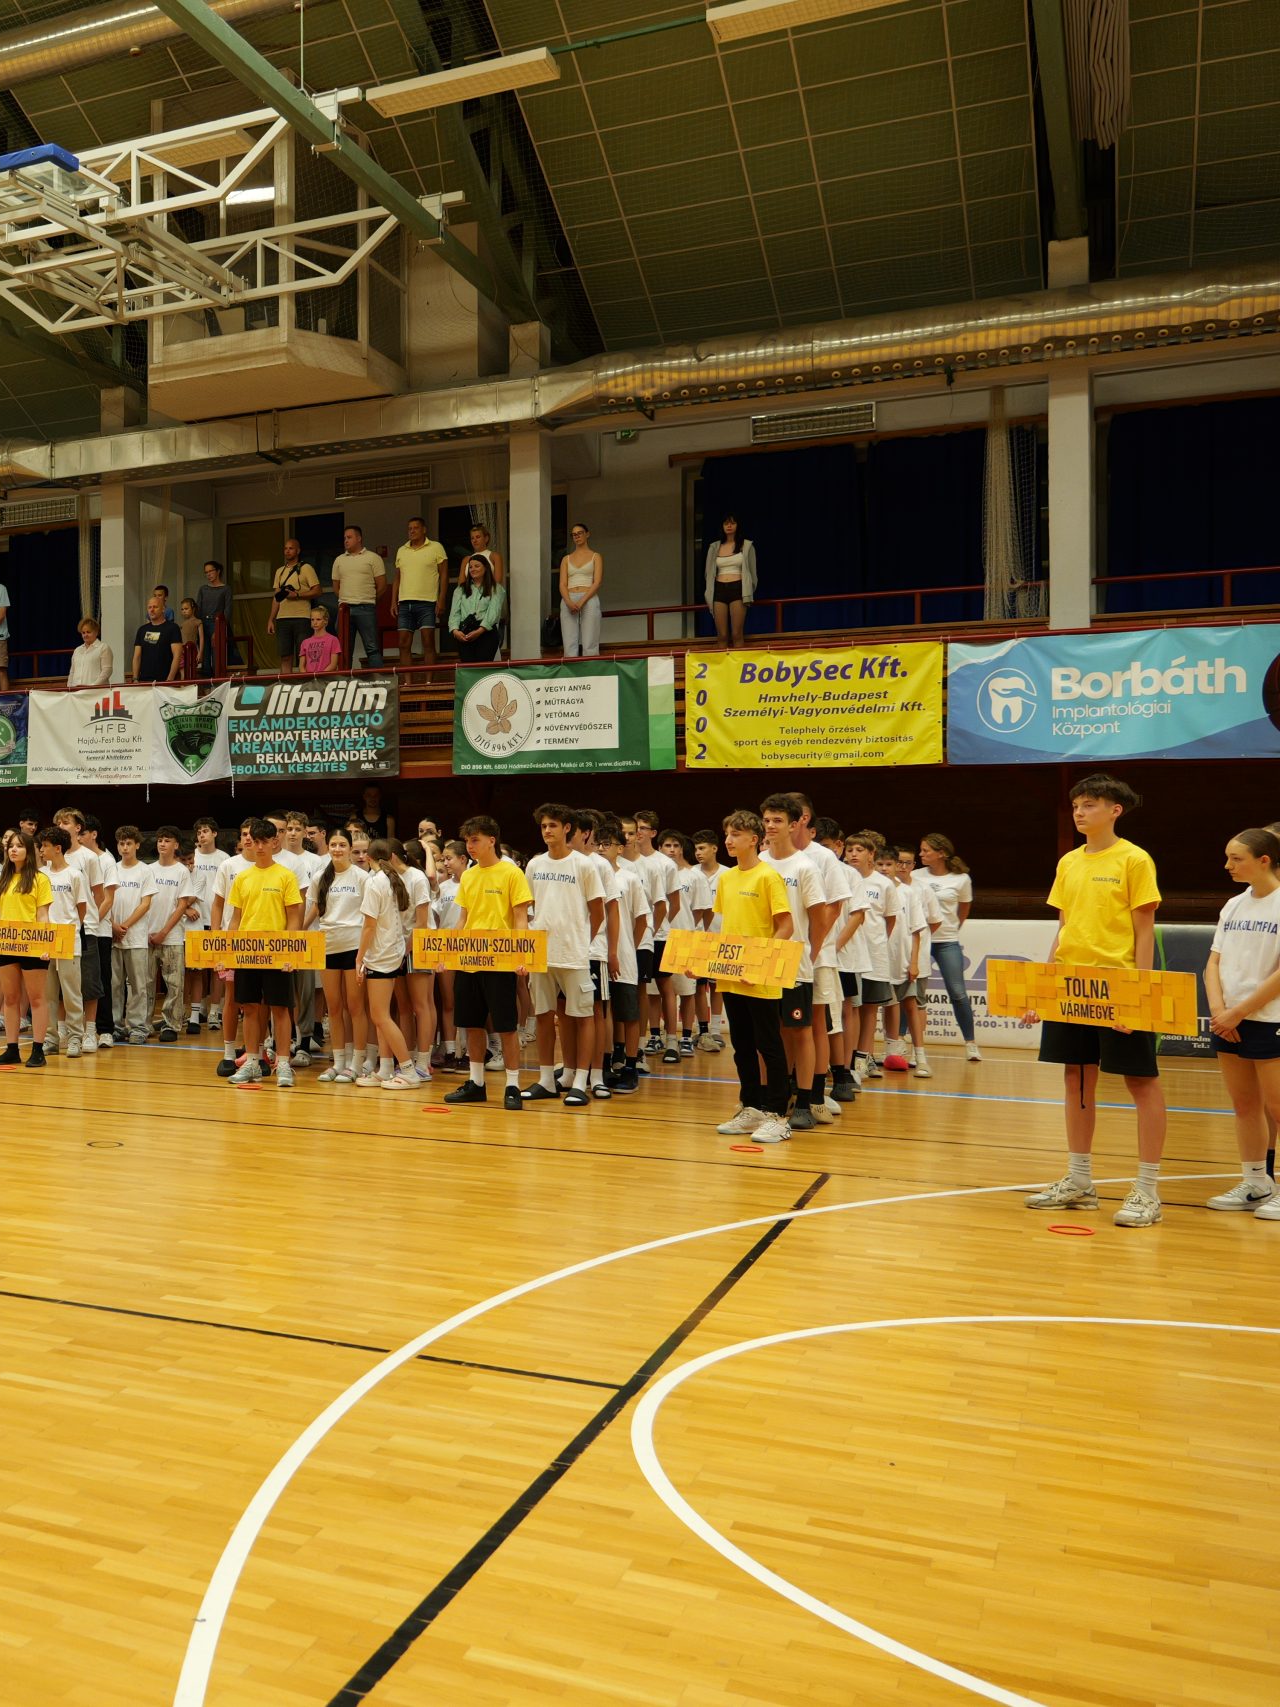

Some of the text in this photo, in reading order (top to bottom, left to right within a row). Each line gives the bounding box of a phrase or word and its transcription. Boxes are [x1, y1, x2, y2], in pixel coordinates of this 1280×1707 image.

[739, 655, 908, 687] BobySec Kft.
[1051, 655, 1247, 701] Borbáth
[567, 684, 592, 692] ANYAG
[265, 680, 388, 716] litofilm
[544, 697, 585, 705] MŰTRÁGYA
[757, 690, 889, 704] Hmvhely-Budapest
[723, 701, 926, 719] Személyi-Vagyonvédelmi Kft.
[1052, 699, 1171, 721] Implantológiai
[94, 723, 127, 734] HFB
[228, 710, 384, 732] EKLÁMDEKORÁCIÓ
[544, 722, 613, 732] NÖVÉNYVÉDŐSZER
[1052, 720, 1121, 739] Központ
[235, 725, 369, 743] NYOMDATERMÉKEK
[779, 726, 826, 736] Telephely
[116, 736, 130, 744] Bau
[302, 734, 385, 752] TERVEZÉS
[473, 734, 491, 750] DIÓ
[491, 742, 507, 752] 896
[543, 736, 580, 745] TERMÉNY
[733, 733, 914, 748] sport és egyéb rendezvény biztosítás
[256, 747, 378, 764] REKLÁMAJÁNDÉK
[761, 750, 884, 761] bobysecurity@gmail.com
[231, 764, 285, 775] EBOLDAL
[288, 761, 348, 774] KÉSZÍTÉS
[155, 878, 179, 887] KOLIMPIA
[422, 935, 536, 953] JÁSZ-NAGYKUN-SZOLNOK
[717, 943, 743, 961] PEST
[236, 954, 273, 965] VÁRMEGYE
[459, 954, 495, 967] VÁRMEGYE
[707, 959, 745, 977] VÁRMEGYE
[1063, 976, 1111, 1000] TOLNA
[1060, 999, 1115, 1021] VÁRMEGYE
[926, 1019, 952, 1027] obil:
